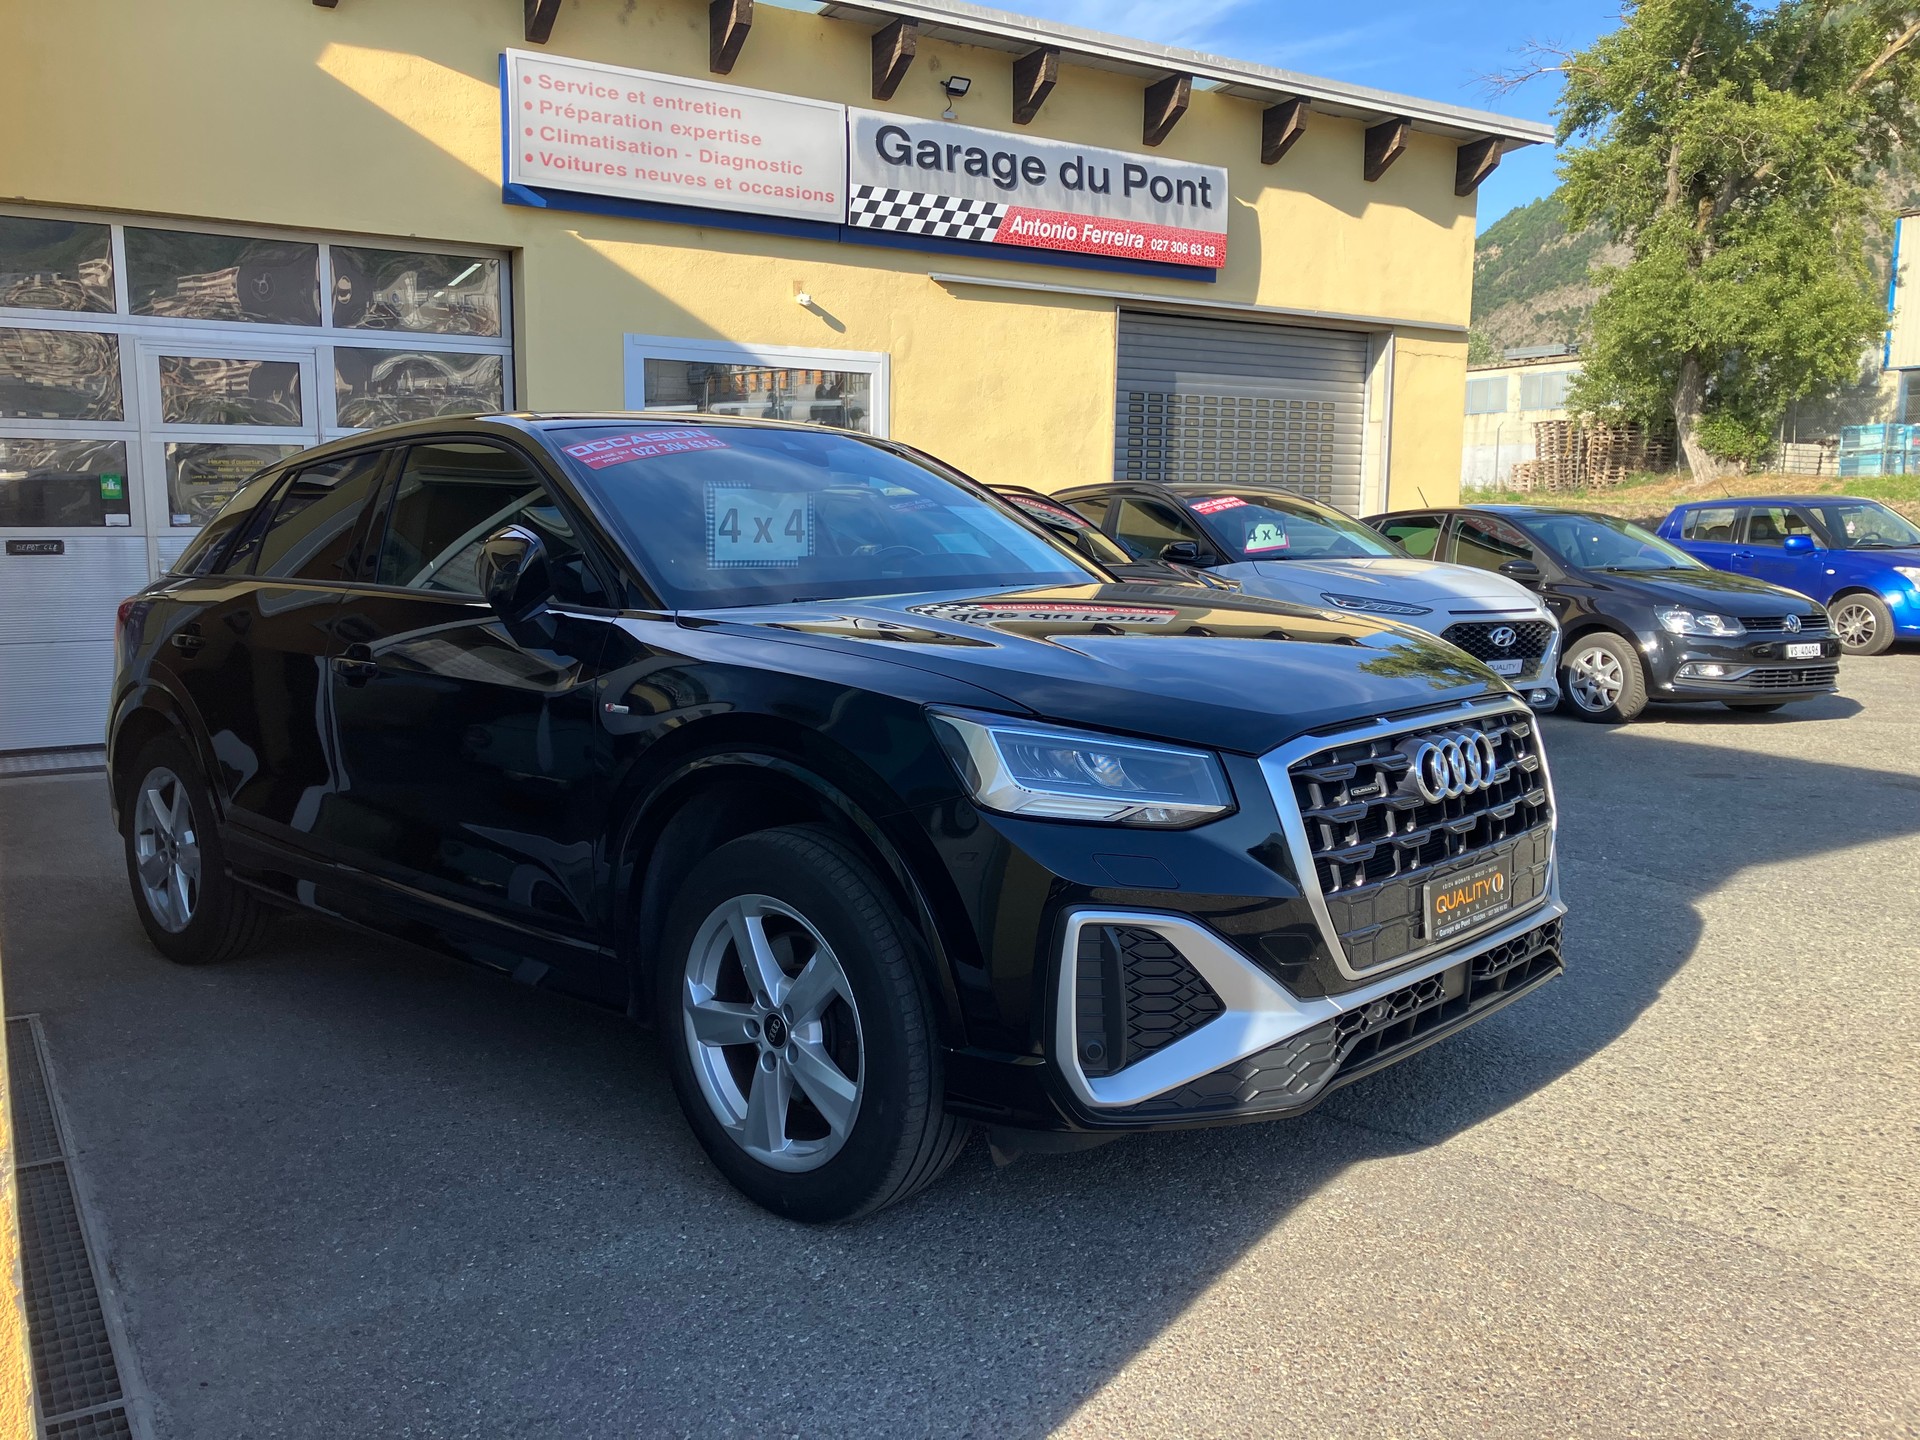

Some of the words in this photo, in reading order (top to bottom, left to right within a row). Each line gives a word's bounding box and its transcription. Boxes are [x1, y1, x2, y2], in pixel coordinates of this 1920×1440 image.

[538, 74, 619, 101] Service
[627, 86, 646, 105] et
[652, 93, 742, 120] entretien
[539, 99, 663, 133] Préparation
[670, 119, 762, 147] expertise
[539, 126, 678, 159] Climatisation
[699, 149, 803, 176] Diagnostic
[875, 125, 1046, 191] Garage
[1059, 155, 1110, 194] du
[1123, 162, 1212, 209] Pont
[540, 151, 627, 177] Voitures
[634, 168, 707, 188] neuves
[714, 175, 733, 191] et
[738, 181, 835, 203] occasions
[1009, 215, 1078, 241] Antonio
[1081, 223, 1144, 249] Ferreira
[1150, 239, 1169, 252] 027
[1171, 241, 1188, 255] 306
[1190, 243, 1202, 256] 63
[1203, 245, 1216, 258] 63
[566, 429, 710, 457] OCCASION
[630, 445, 661, 456] 027
[659, 441, 688, 452] 306
[718, 508, 741, 544] 4
[753, 517, 773, 544] x
[784, 508, 806, 544] 4
[1247, 528, 1258, 542] 4
[1262, 529, 1272, 541] x
[1275, 525, 1284, 539] 4
[1489, 663, 1517, 671] QUALITY
[1789, 646, 1798, 656] VS
[1436, 877, 1491, 914] QUALITY
